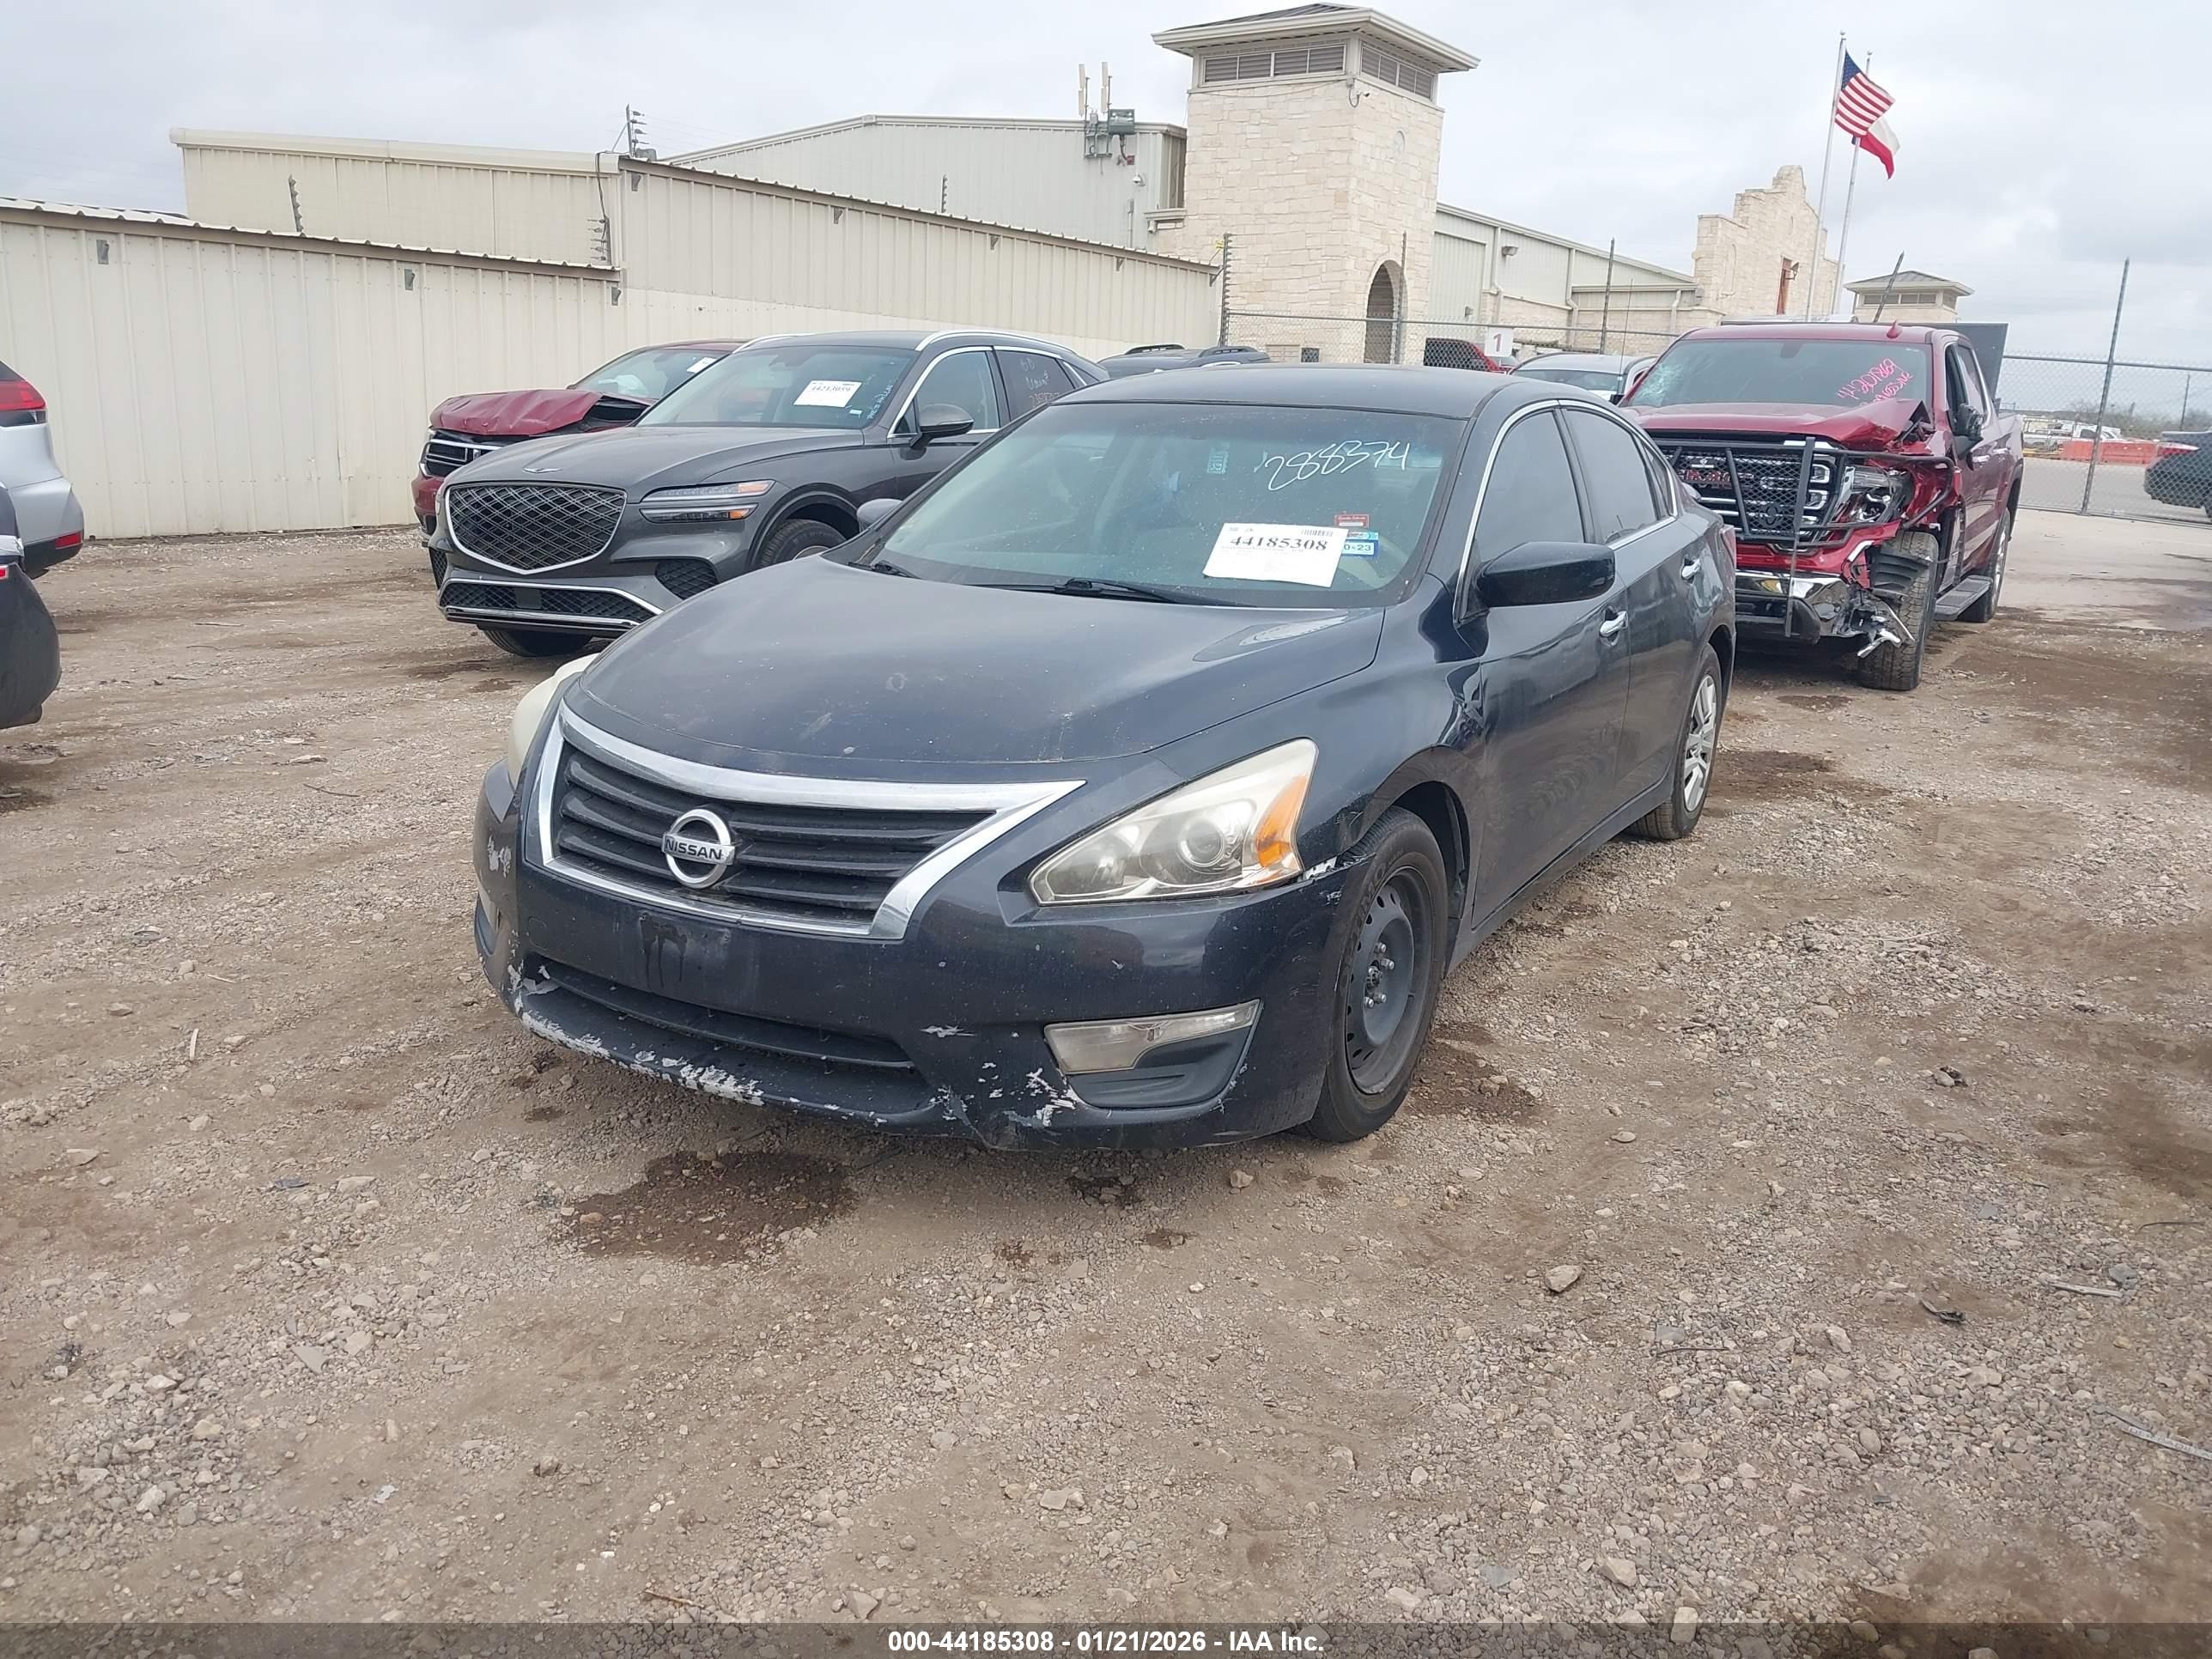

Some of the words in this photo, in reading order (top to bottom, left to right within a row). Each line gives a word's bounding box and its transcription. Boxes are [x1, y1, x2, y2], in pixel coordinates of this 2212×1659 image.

[1492, 333, 1502, 352] 1
[1229, 536, 1329, 551] 44185308
[665, 839, 723, 860] NISSAN
